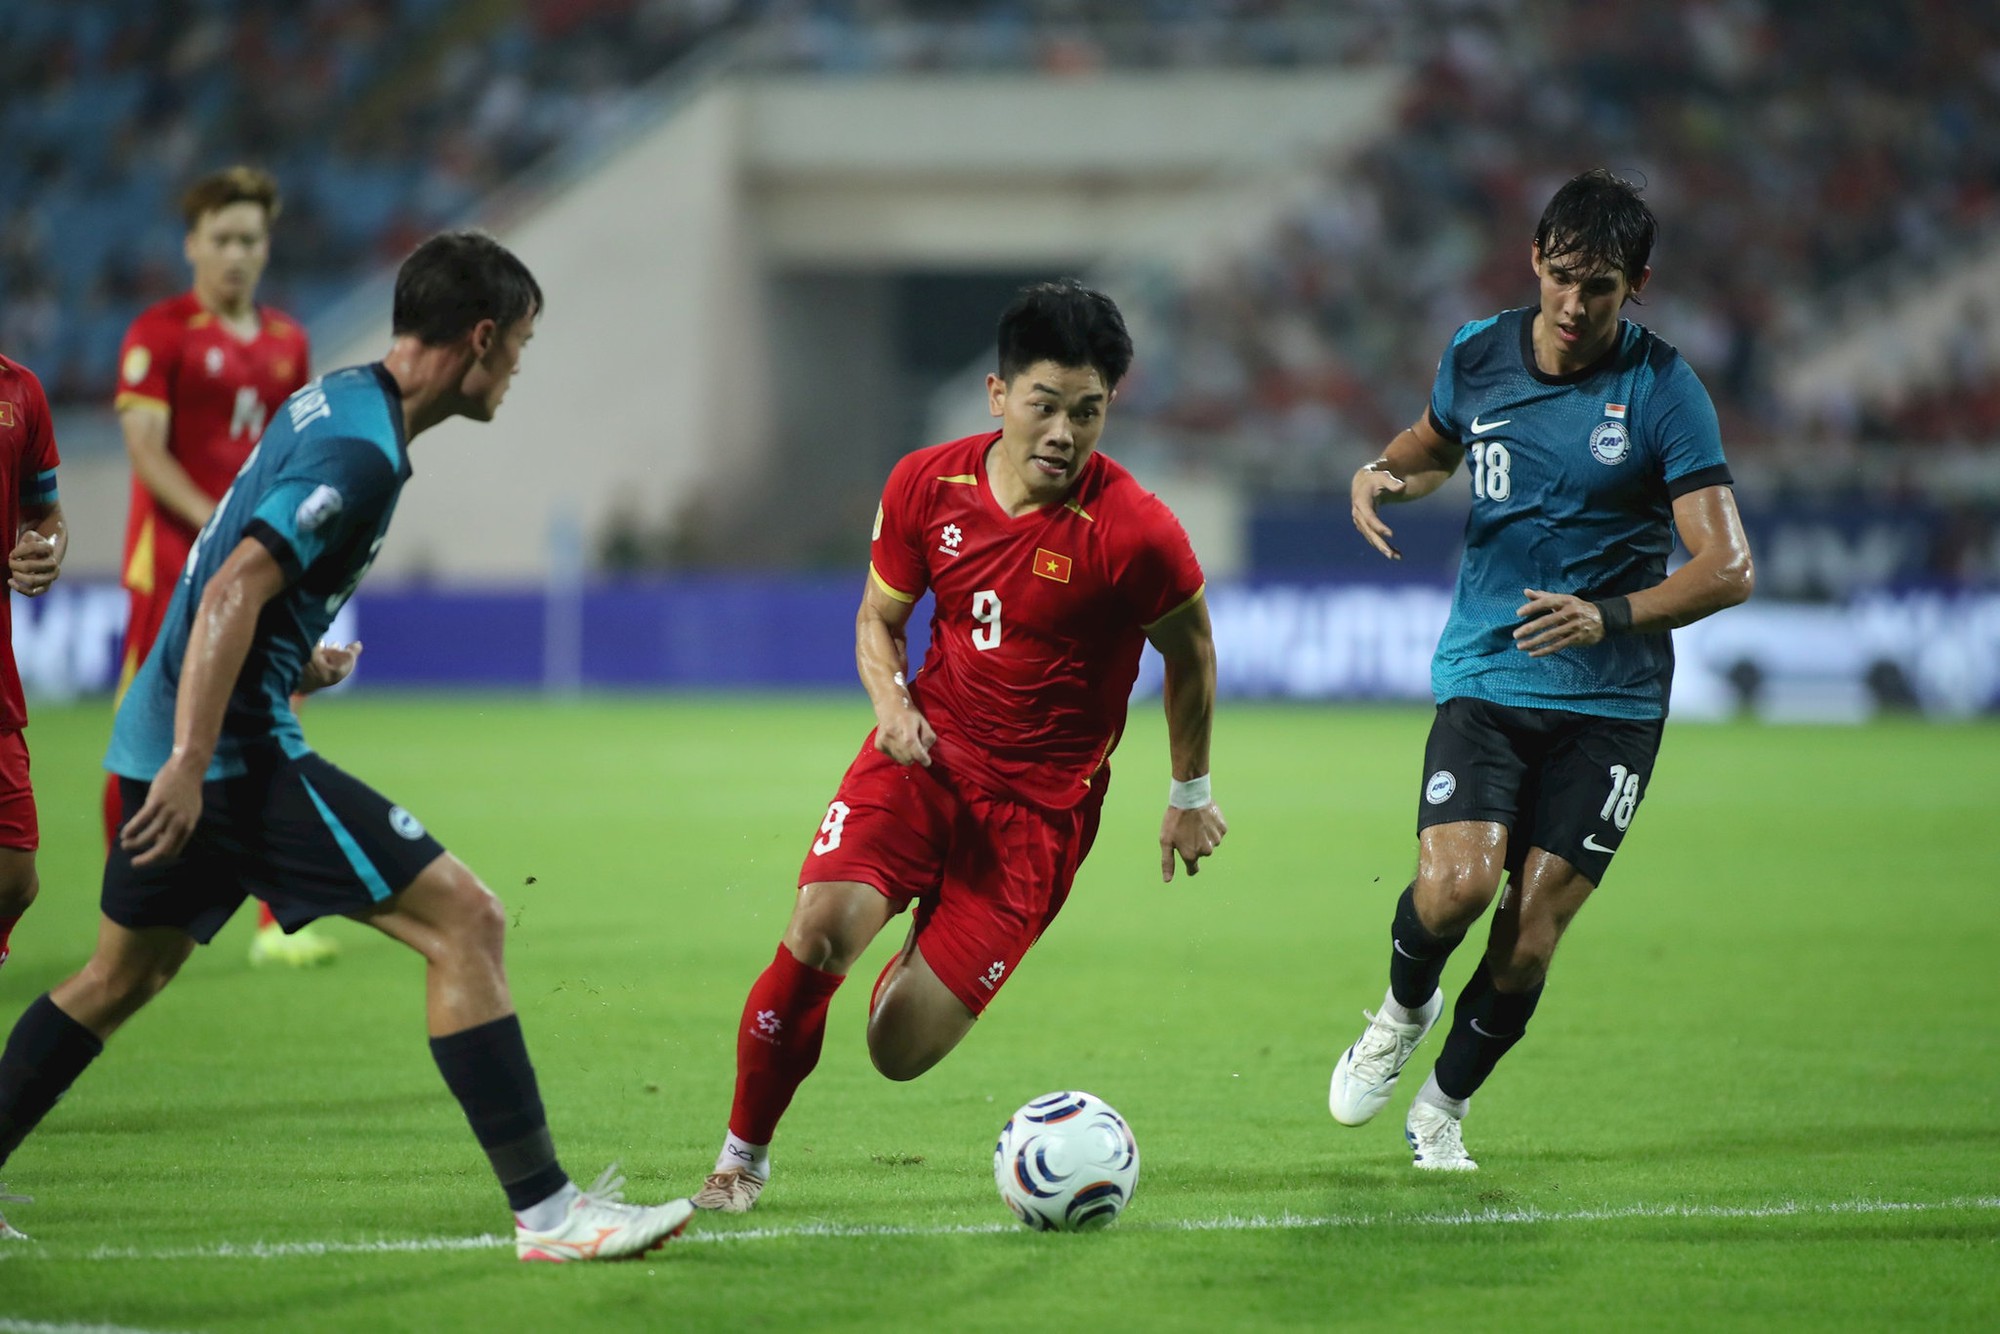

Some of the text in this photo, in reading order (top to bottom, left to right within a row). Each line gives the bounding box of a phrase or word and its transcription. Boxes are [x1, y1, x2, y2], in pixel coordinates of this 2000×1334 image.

[1472, 441, 1511, 502] 18
[971, 589, 1002, 652] 9
[812, 800, 851, 857] 9
[1600, 764, 1640, 832] 18
